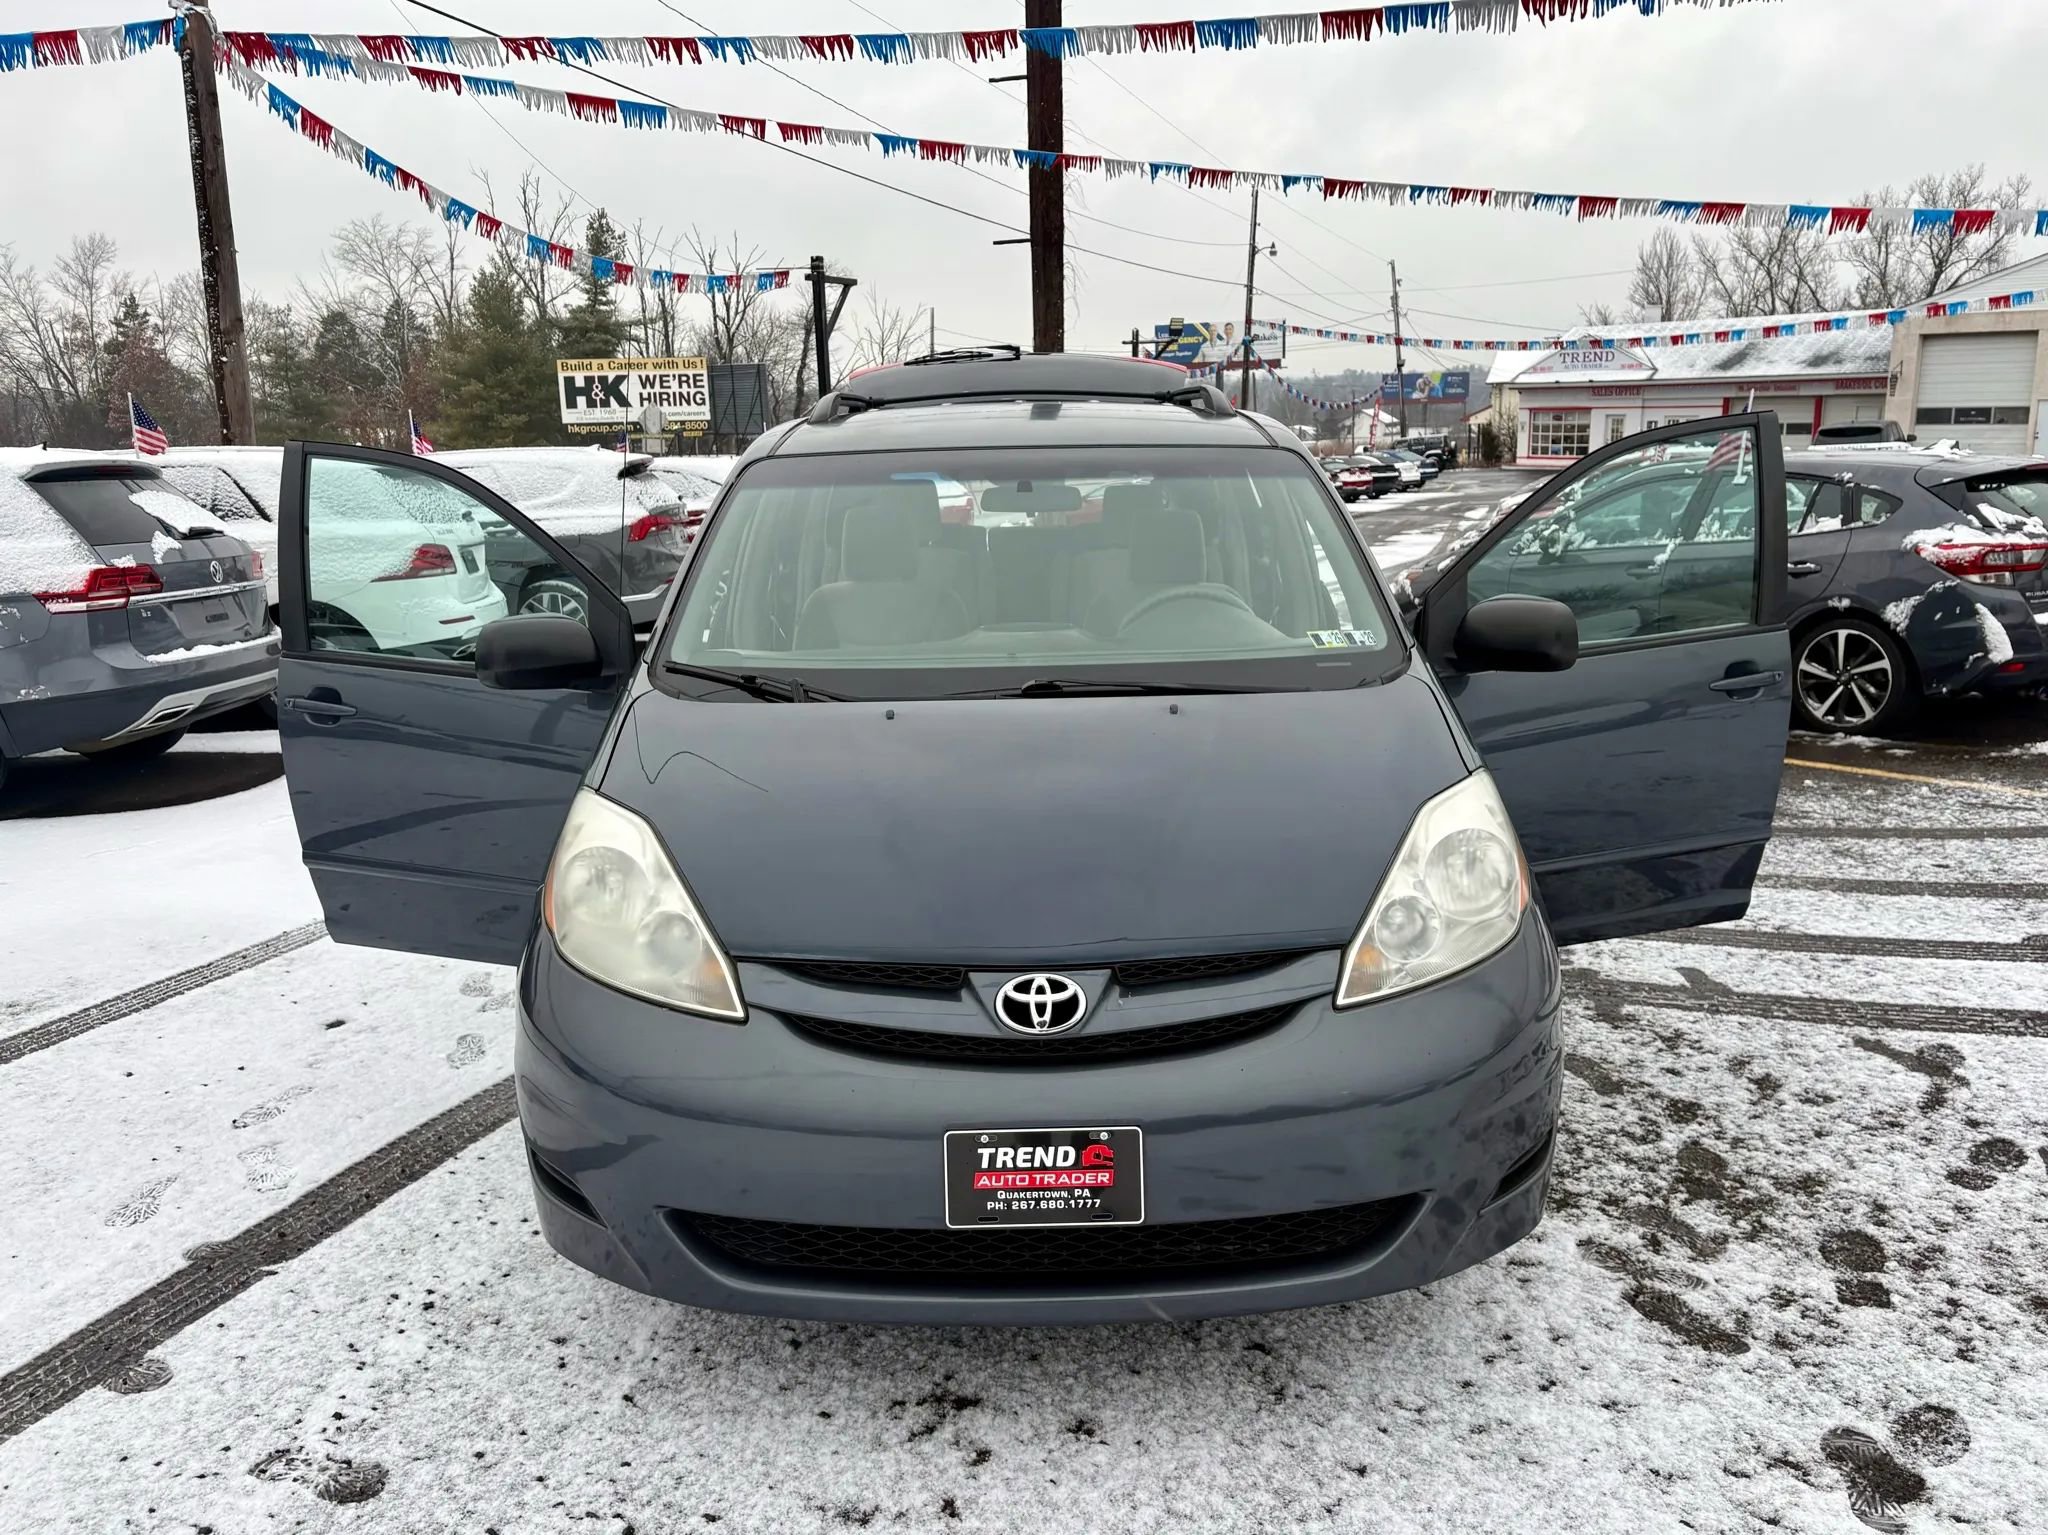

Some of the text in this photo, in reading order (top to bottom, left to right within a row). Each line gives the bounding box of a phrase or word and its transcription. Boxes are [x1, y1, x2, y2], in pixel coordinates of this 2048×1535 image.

[1559, 351, 1615, 364] TREND
[561, 361, 593, 372] Build
[597, 362, 604, 371] a
[608, 360, 649, 371] Career
[652, 359, 679, 370] with
[638, 373, 705, 390] WE'RE
[563, 374, 633, 410] H&K
[1592, 386, 1641, 397] SALES OFFICE
[639, 391, 706, 408] HIRING
[977, 1145, 1076, 1169] TREND
[977, 1172, 1110, 1187] AUTO TRADER
[1074, 1188, 1091, 1198] PA
[987, 1199, 1101, 1211] PH: 267.680.1777
